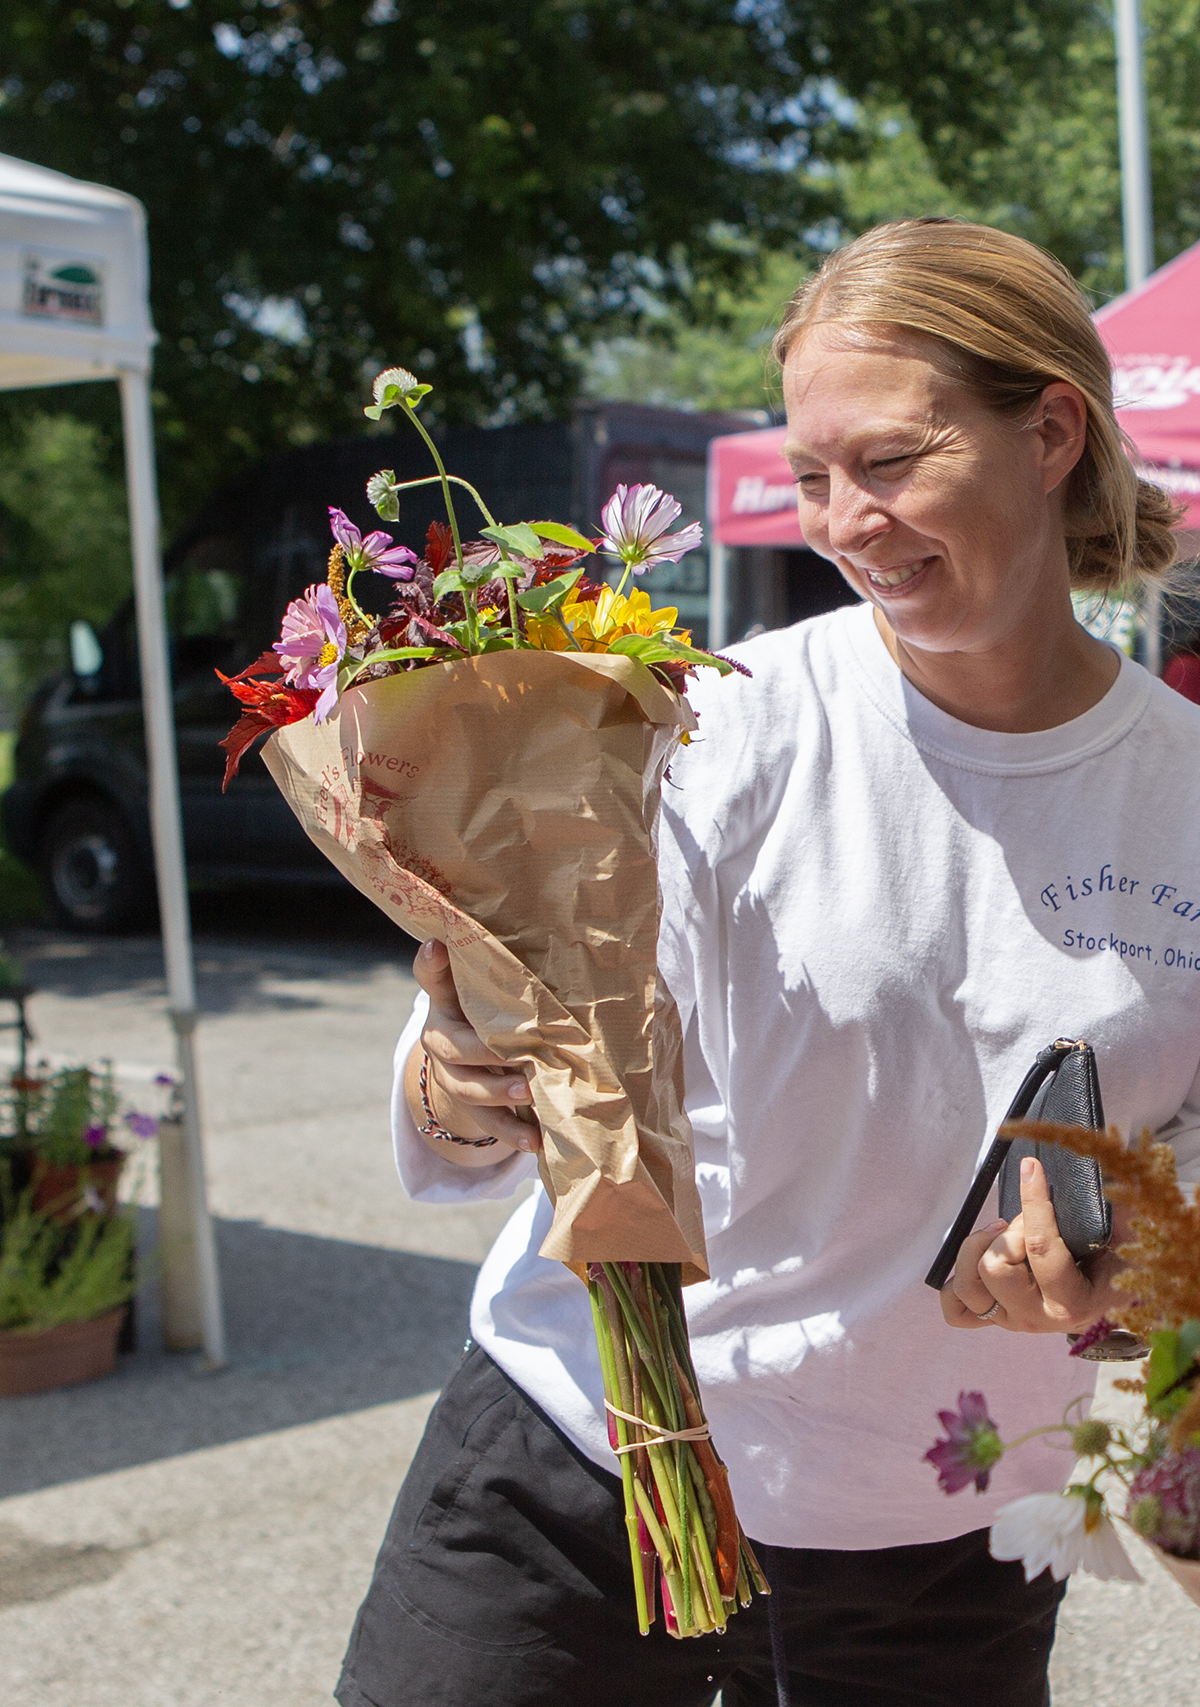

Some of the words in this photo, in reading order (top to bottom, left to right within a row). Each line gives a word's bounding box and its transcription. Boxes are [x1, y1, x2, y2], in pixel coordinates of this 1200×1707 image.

[314, 764, 341, 826] Fred's
[340, 745, 420, 779] Flowers
[1040, 864, 1140, 912] Fisher
[1063, 929, 1158, 965] Stockport,
